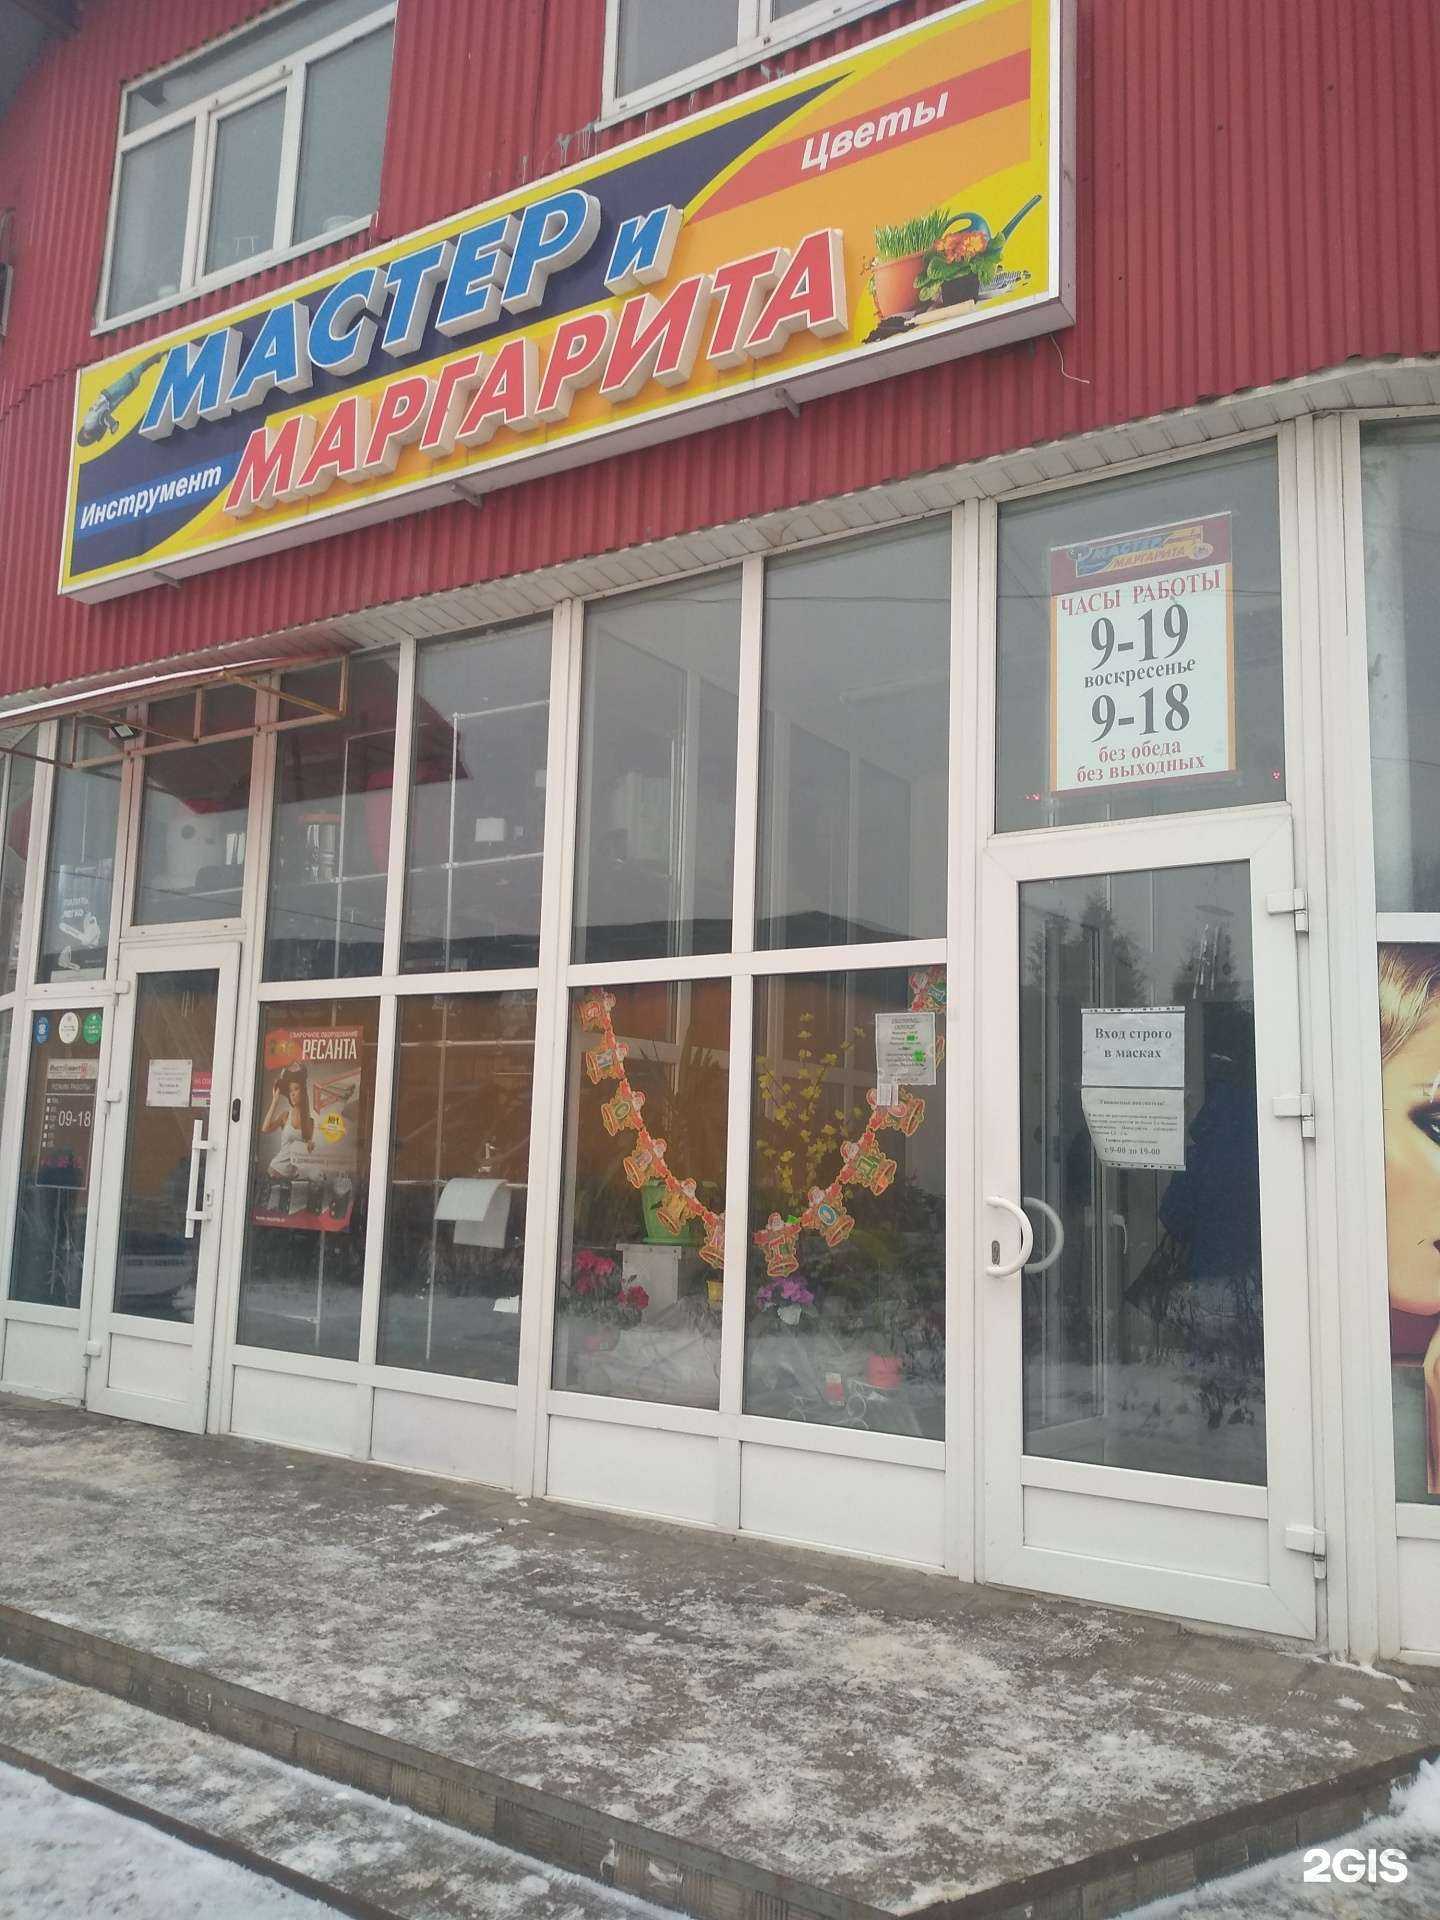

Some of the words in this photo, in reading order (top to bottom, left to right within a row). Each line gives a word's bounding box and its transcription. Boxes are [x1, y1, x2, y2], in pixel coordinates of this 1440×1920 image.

[801, 92, 949, 173] Цветы
[139, 189, 598, 440] МАСТЕР
[604, 205, 680, 290] и
[224, 228, 847, 515] МАРГАРИТА
[80, 463, 222, 531] Инструмент
[1061, 589, 1121, 617] ЧАСЫ
[1133, 569, 1220, 604] РАБОТЫ
[1090, 603, 1189, 671] 9-19
[1084, 658, 1196, 688] воскресенье
[1090, 683, 1190, 743] 9-18
[1077, 766, 1104, 783] без
[1109, 754, 1207, 779] выходных
[1099, 746, 1125, 763] без
[1131, 741, 1182, 760] обеда
[302, 1039, 357, 1060] РЕСАНТА
[1095, 1028, 1125, 1040] Вход
[1129, 1031, 1172, 1042] строго
[1104, 1050, 1112, 1058] в
[1115, 1050, 1162, 1058] масках
[58, 1110, 91, 1127] 09-18
